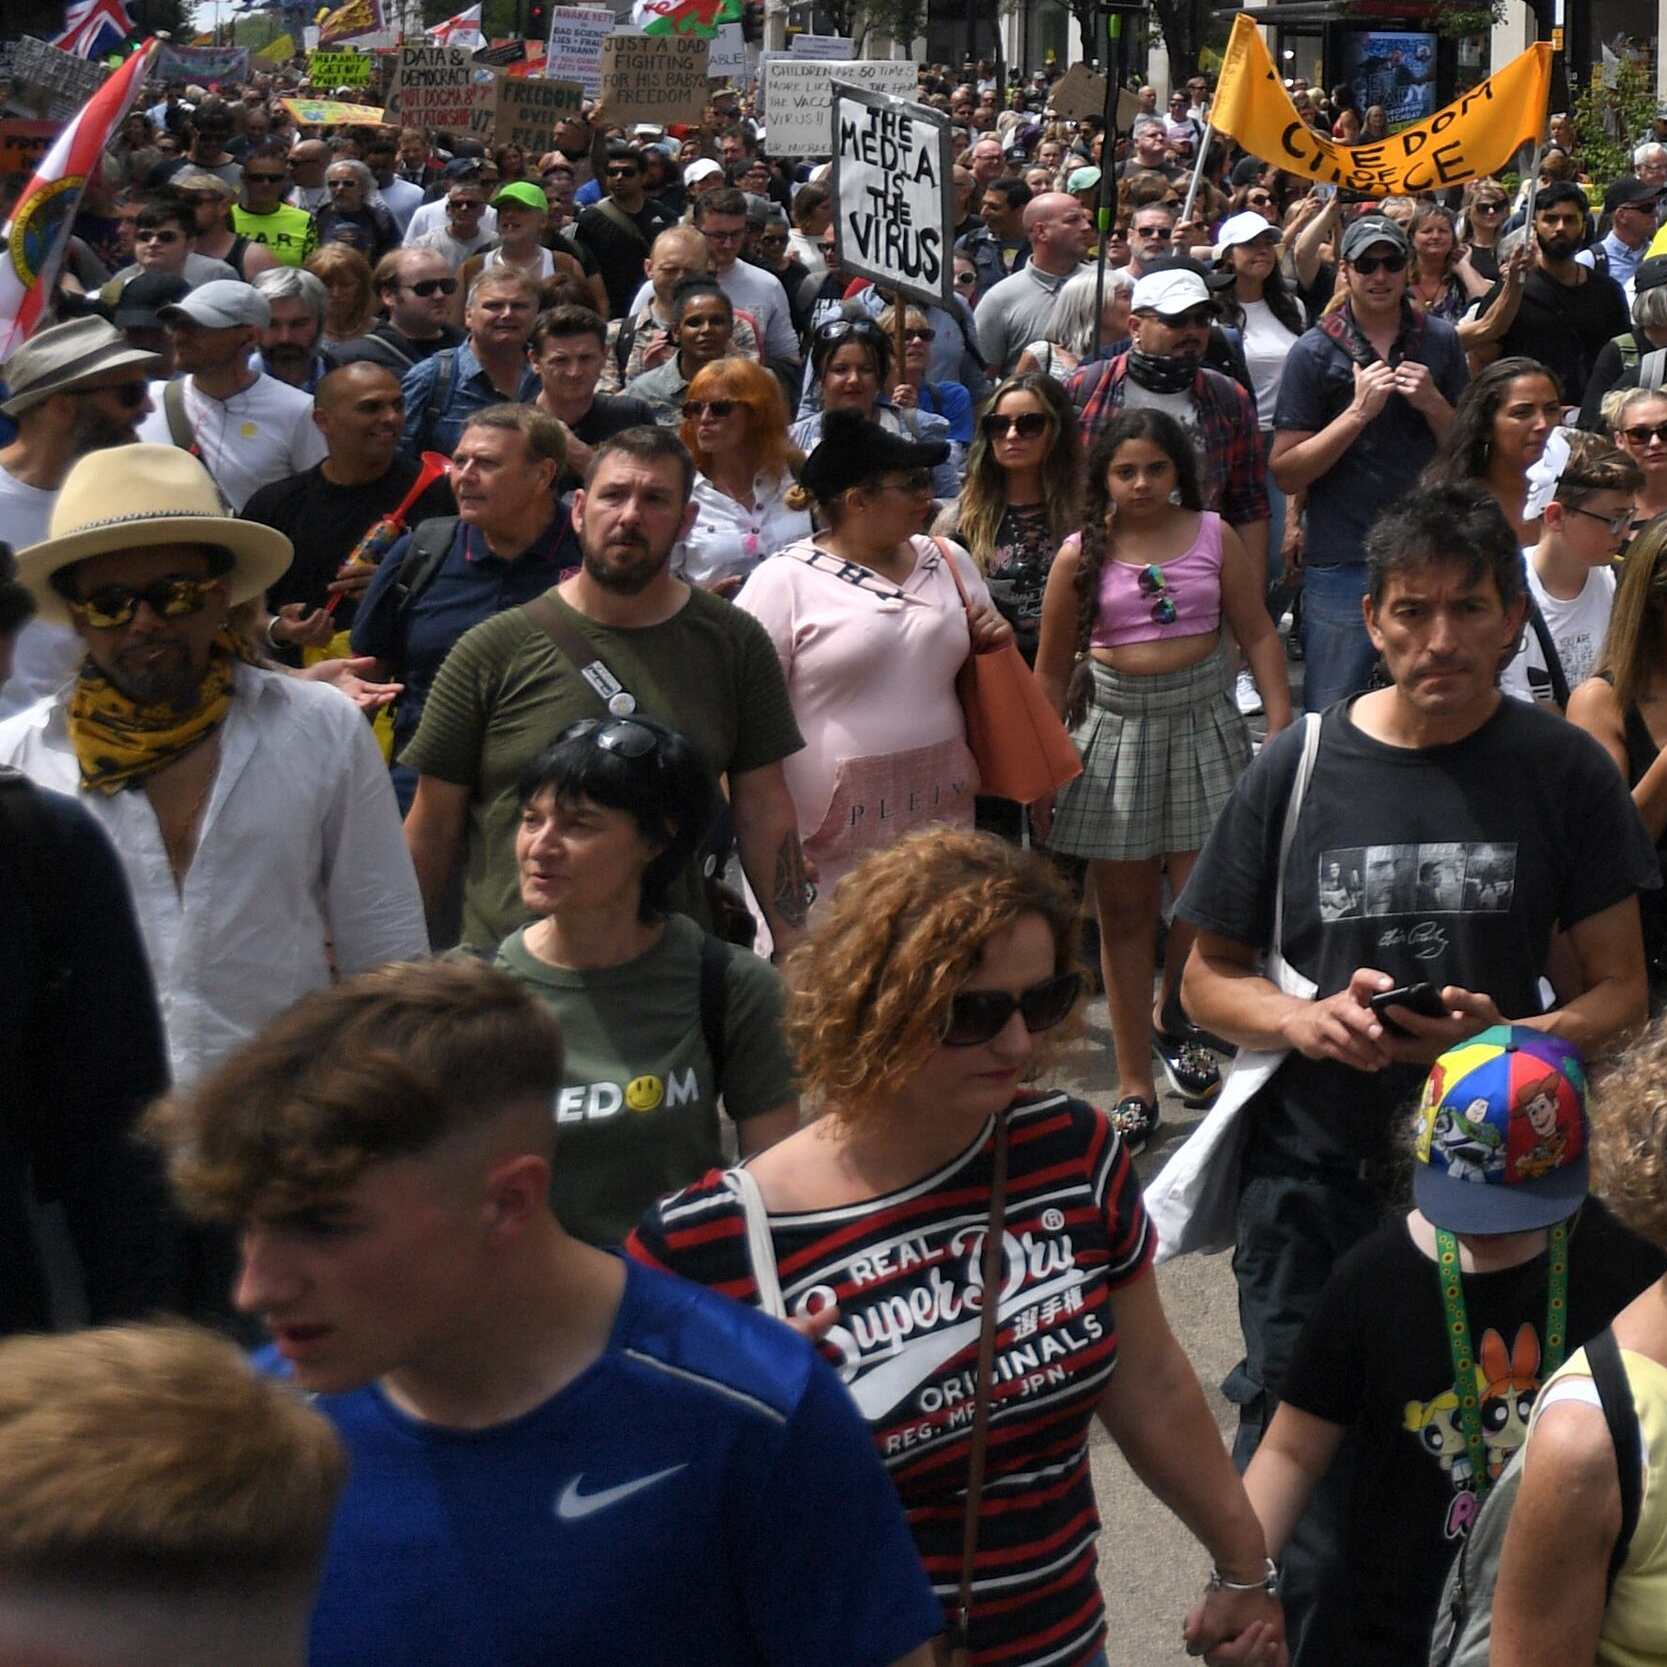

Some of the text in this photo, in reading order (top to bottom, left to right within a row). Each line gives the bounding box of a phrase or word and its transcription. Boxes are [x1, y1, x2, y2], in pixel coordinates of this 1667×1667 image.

[574, 28, 606, 37] SCIENC
[580, 38, 603, 47] FRAU
[603, 37, 707, 53] JUST A DAD
[403, 47, 446, 66] DATA
[450, 48, 465, 66] &
[614, 55, 695, 70] FIGHTING
[400, 67, 471, 86] DEMOCRACY
[603, 73, 628, 88] FOR
[636, 73, 658, 88] HIS
[771, 65, 832, 78] CHILDREN
[859, 65, 876, 78] 50
[879, 65, 914, 76] TIMES
[769, 81, 800, 92] MORE
[400, 87, 420, 107] NOT
[424, 86, 461, 107] DOGMA
[504, 84, 585, 112] FREEDOM
[616, 89, 692, 105] FREEDOM
[769, 96, 787, 107] THE
[866, 107, 914, 142] THE
[841, 117, 938, 189] MEDIA
[883, 170, 911, 194] IS
[866, 185, 913, 227] THE
[849, 211, 941, 285] VIRUS
[850, 780, 966, 826] PLEIN
[849, 1236, 943, 1287] REAL
[886, 1419, 942, 1455] REG.
[1020, 1362, 1075, 1396] JPN.
